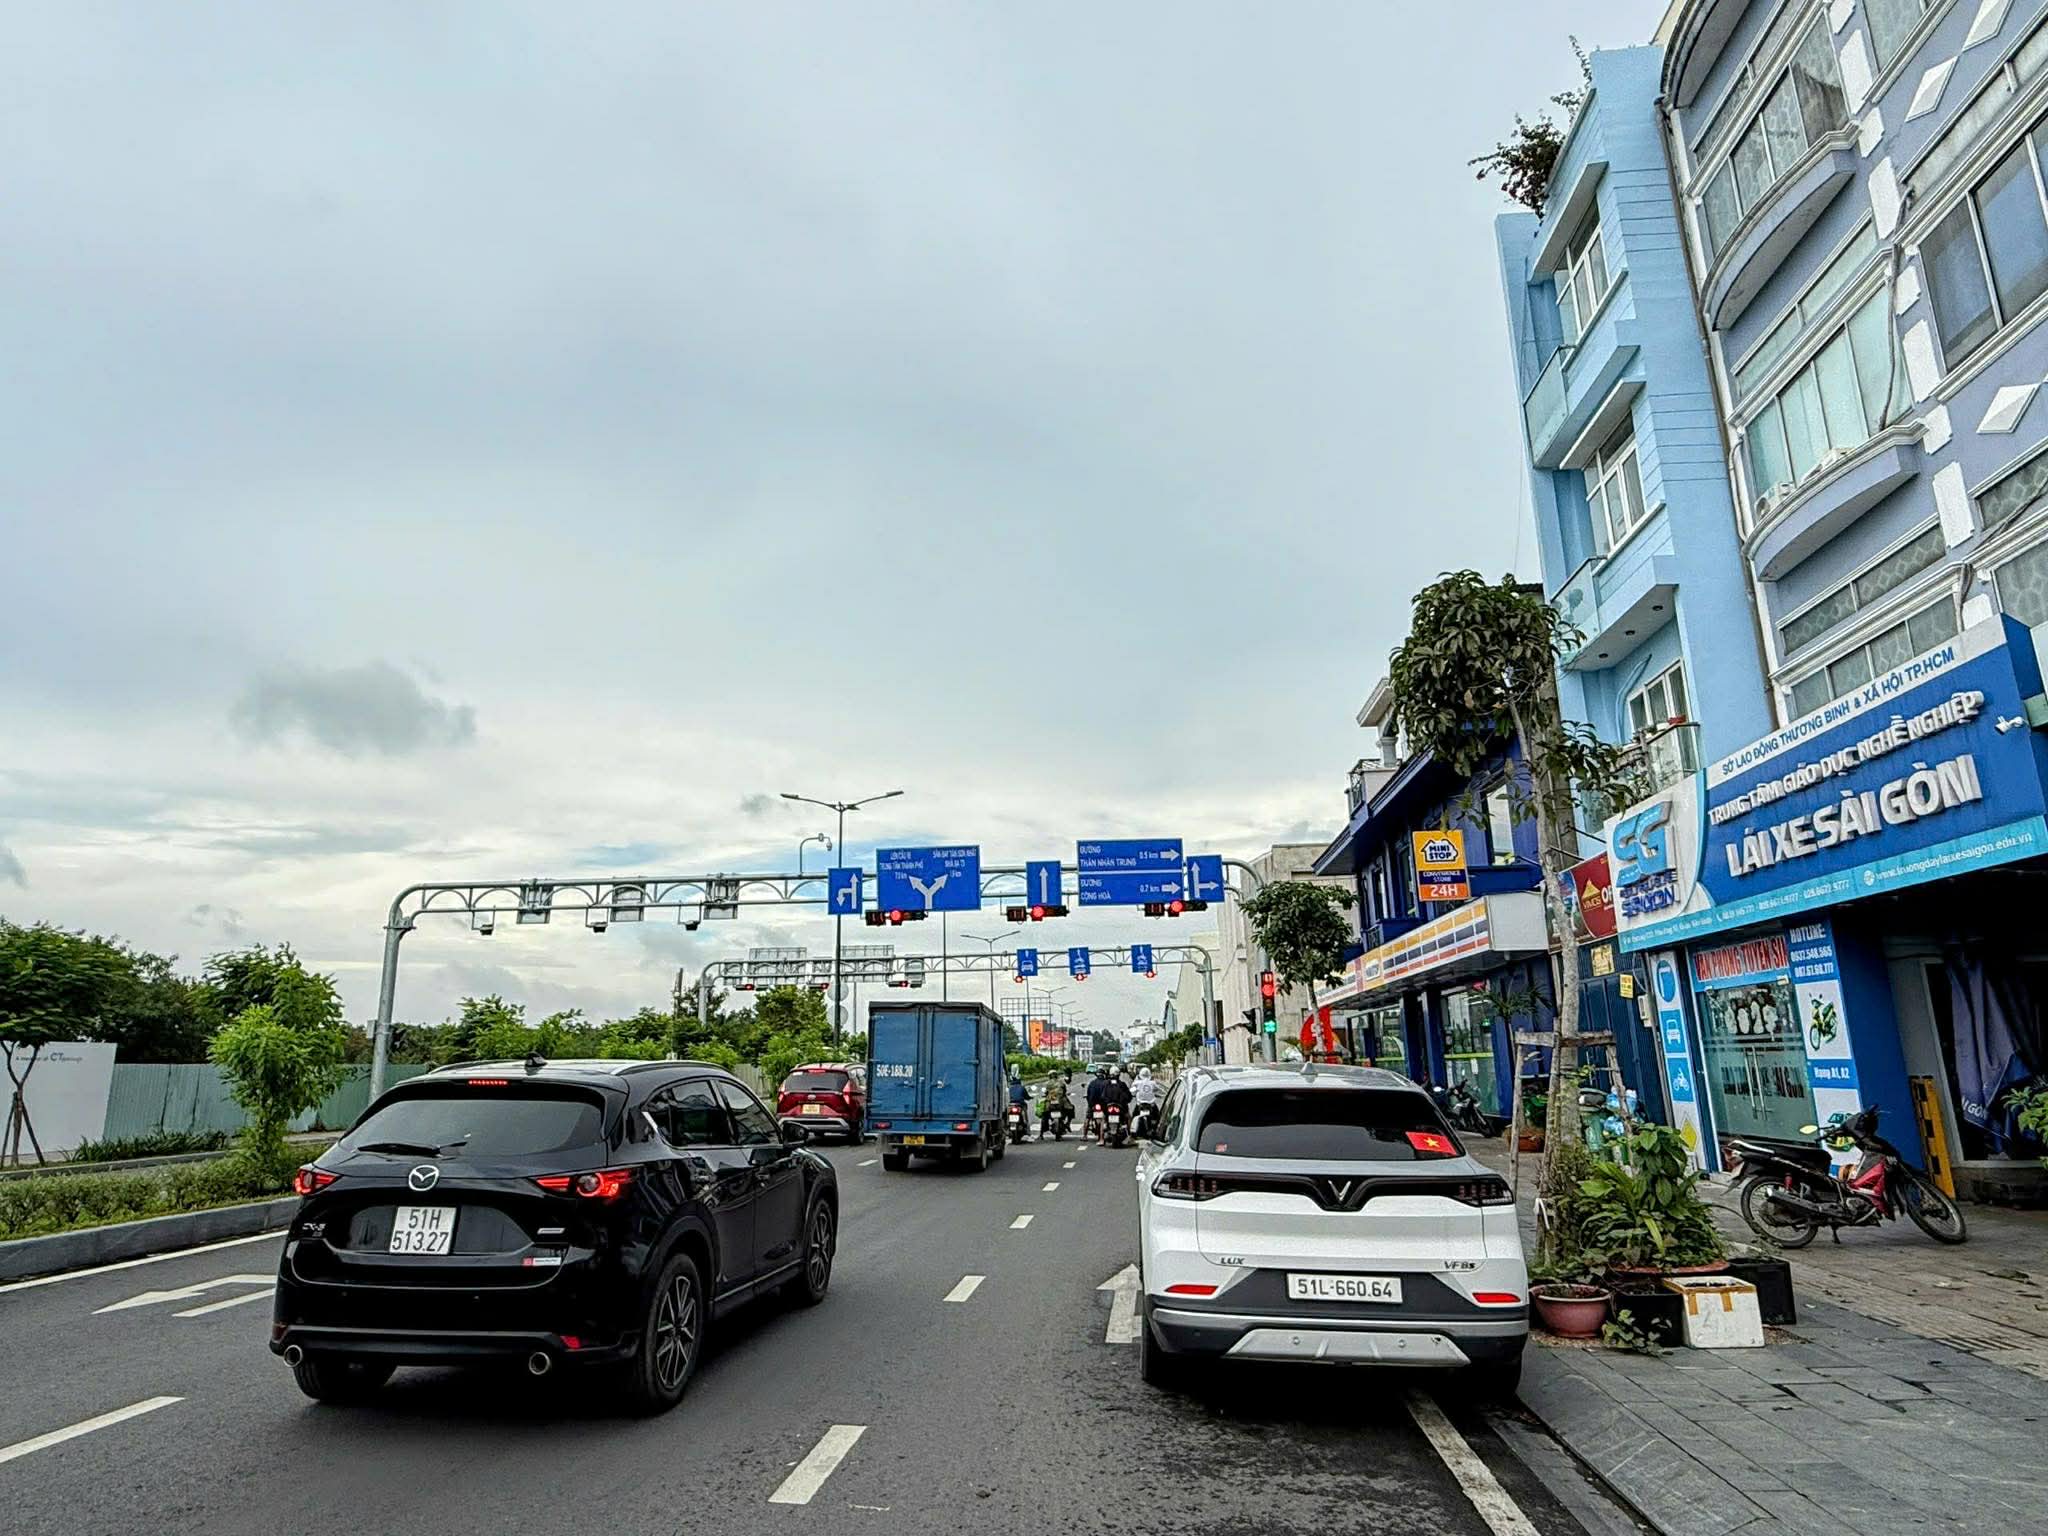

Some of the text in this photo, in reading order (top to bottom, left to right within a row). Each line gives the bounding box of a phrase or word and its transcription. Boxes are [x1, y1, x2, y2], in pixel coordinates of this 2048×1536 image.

[1722, 760, 1735, 775] SỞ
[1736, 751, 1753, 769] LAO
[1753, 738, 1779, 761] ĐỘNG
[1779, 716, 1824, 745] THƯƠNG
[1824, 702, 1851, 728] BINH
[1863, 681, 1881, 703] XÃ
[1882, 671, 1905, 698] HỘI
[1904, 646, 1955, 683] TP.HCM
[1708, 690, 1985, 825] TRUNG TÂM GIÁO DỤC NGHỀ NGHIỆP
[1725, 753, 1983, 877] LÁI XE SÀI GÒN
[1116, 857, 1137, 867] TRUNG
[1149, 851, 1159, 859] km
[1429, 852, 1452, 860] STOP
[1150, 884, 1160, 893] km
[1431, 884, 1458, 897] 24H
[408, 1208, 442, 1230] 51H
[391, 1231, 450, 1253] 513.27
[1220, 1256, 1246, 1266] LUX
[1297, 1278, 1393, 1299] 51L-660.64
